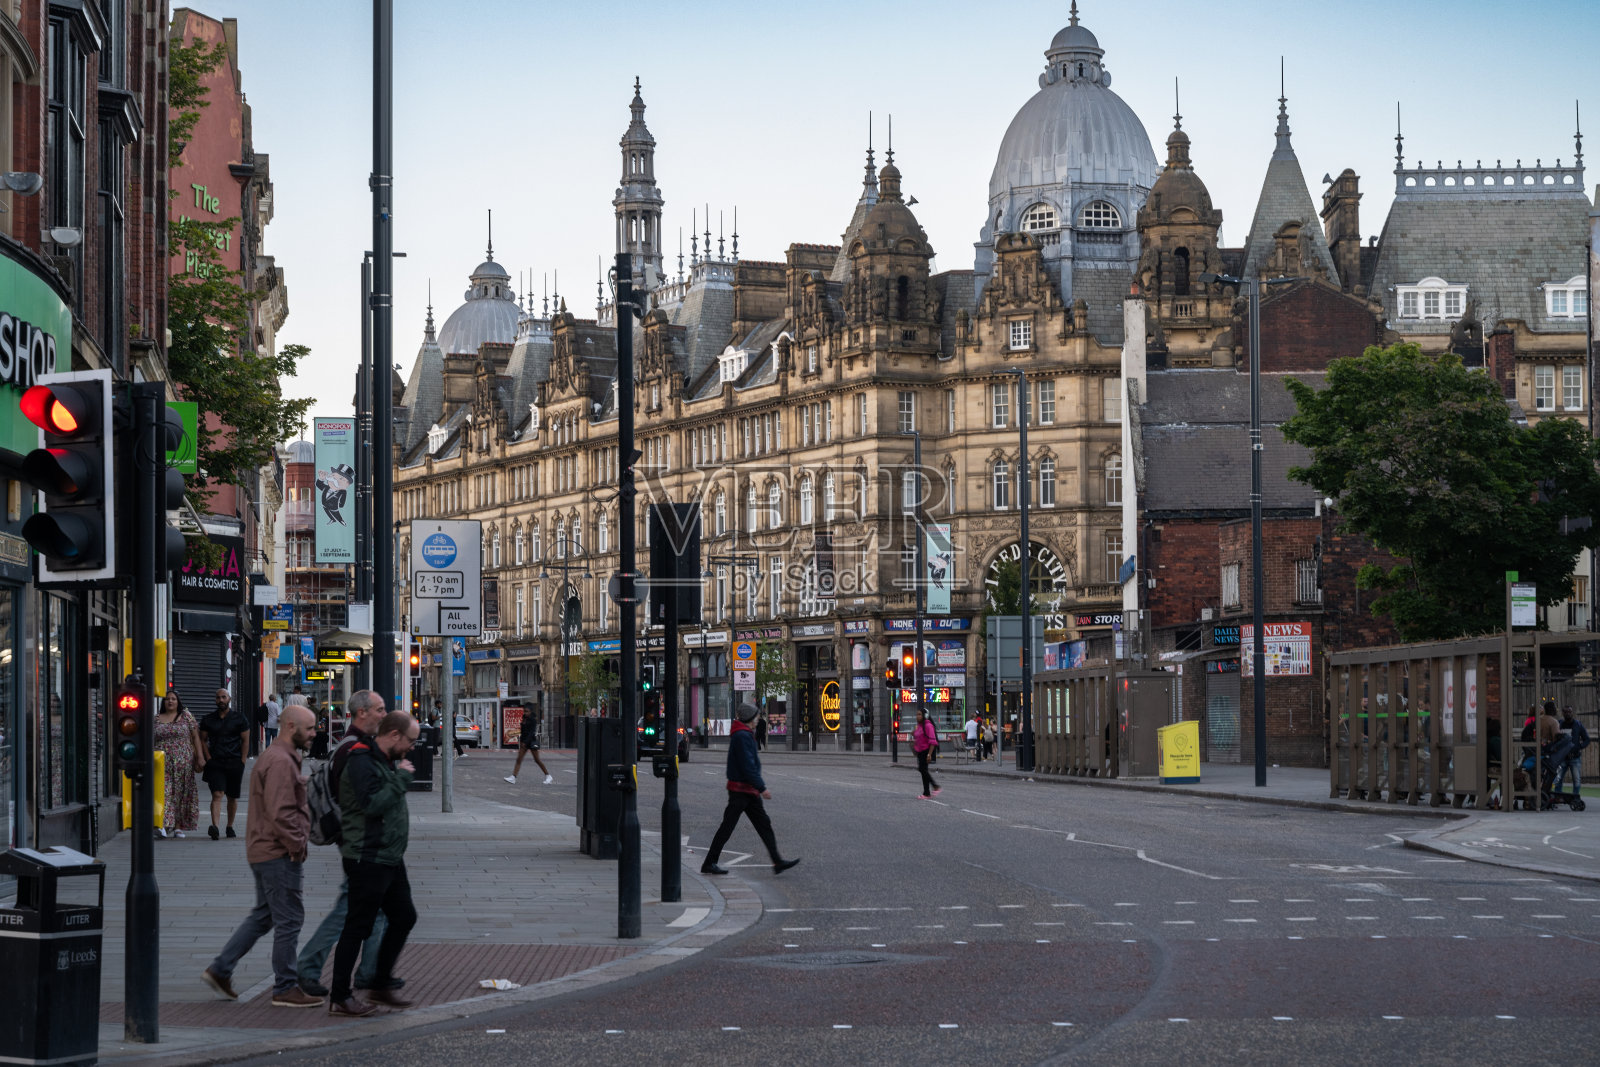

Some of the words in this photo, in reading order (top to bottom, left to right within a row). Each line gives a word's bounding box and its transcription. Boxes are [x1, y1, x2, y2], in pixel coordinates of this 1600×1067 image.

[191, 183, 220, 215] The
[0, 312, 57, 388] SHOP
[984, 542, 1032, 587] LEED
[1037, 547, 1067, 584] CITY
[181, 576, 197, 587] HAIR
[198, 577, 203, 588] &
[204, 577, 239, 591] COSMETICS
[447, 612, 461, 620] All
[1075, 616, 1092, 625] ZAIN
[447, 622, 477, 630] routes
[889, 619, 913, 628] PHONE
[934, 619, 952, 627] YOU
[1214, 627, 1240, 636] DAILY
[1264, 624, 1302, 636] NEWS
[1214, 635, 1240, 644] NEWS
[560, 642, 583, 656] MRKE
[66, 914, 90, 926] LITTER
[71, 947, 97, 963] Leeds
